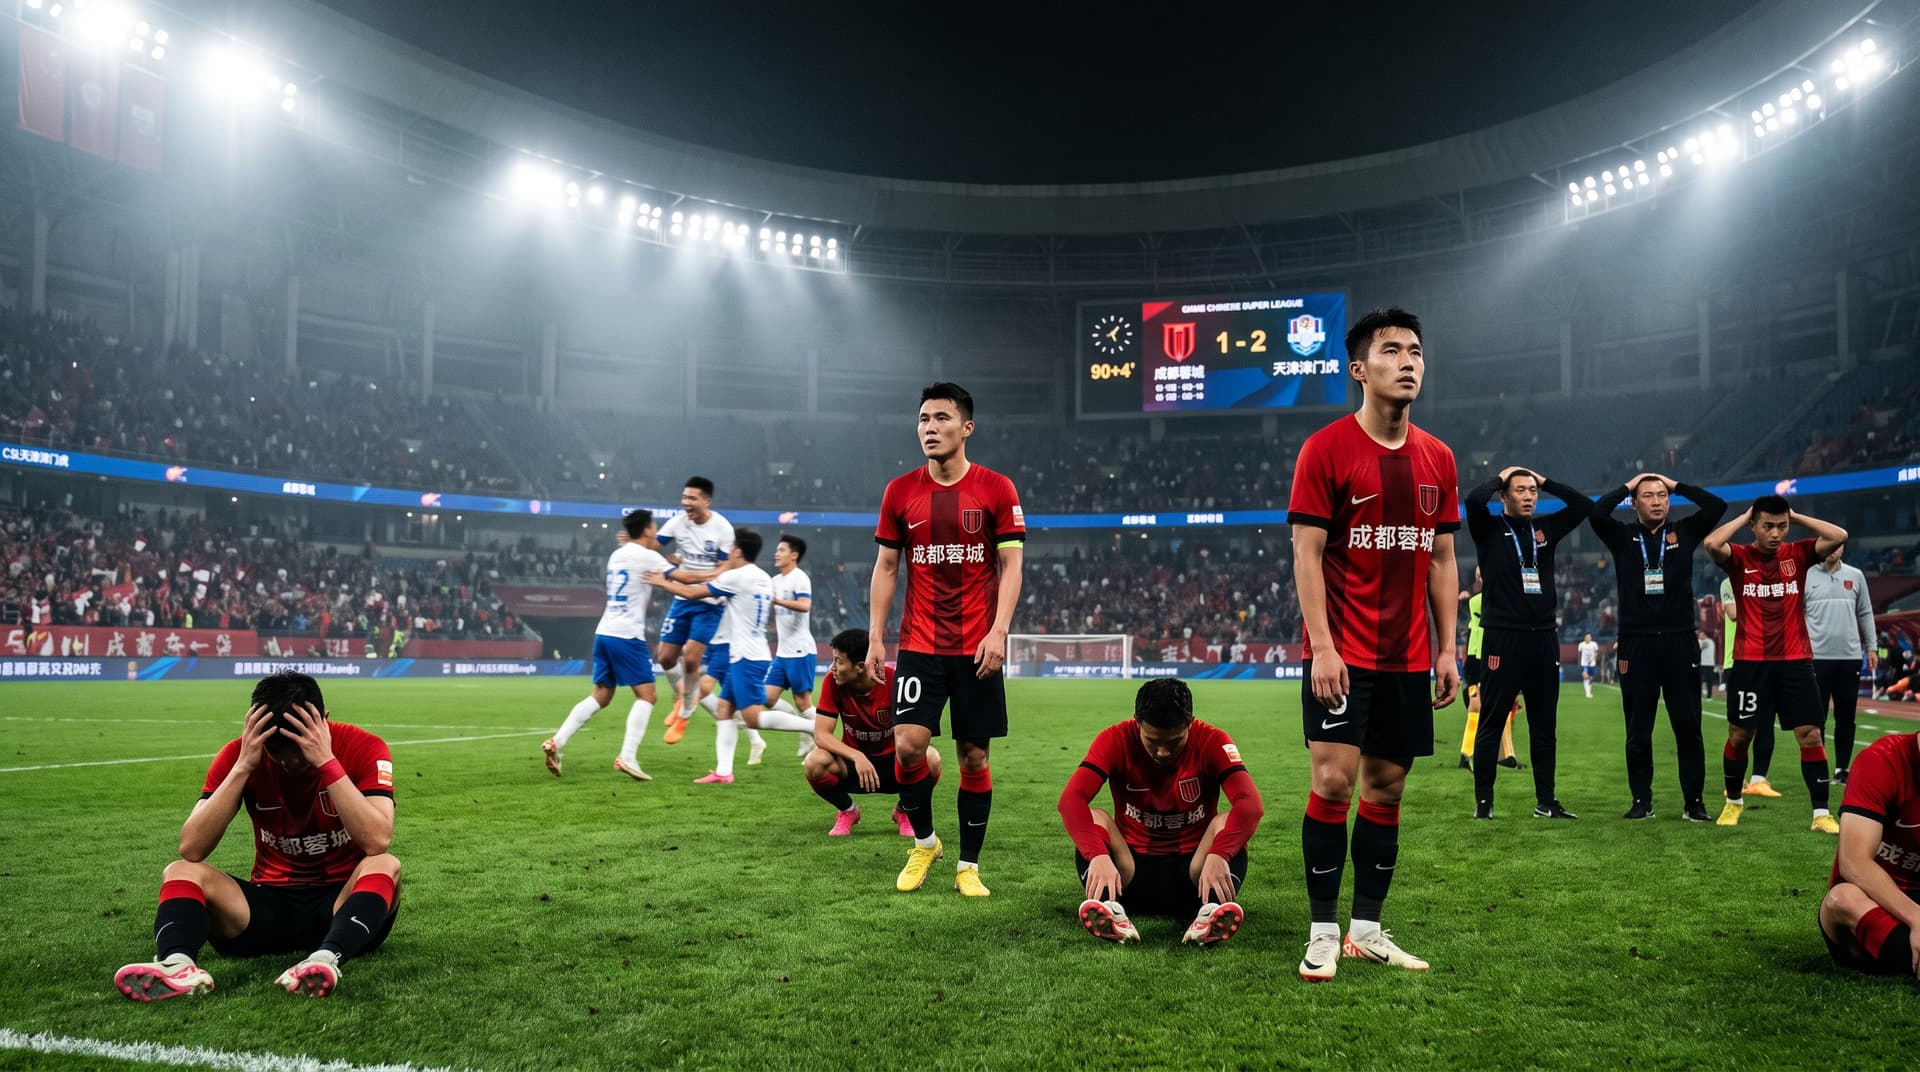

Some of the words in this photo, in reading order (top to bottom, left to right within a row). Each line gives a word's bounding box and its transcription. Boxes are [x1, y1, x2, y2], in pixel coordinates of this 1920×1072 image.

[1348, 525, 1435, 552] 成都蓉城
[912, 543, 984, 564] 成都蓉城
[897, 676, 921, 703] 10
[1738, 691, 1757, 712] 13
[1125, 803, 1205, 829] 成都蓉城
[261, 828, 351, 855] 成都蓉城
